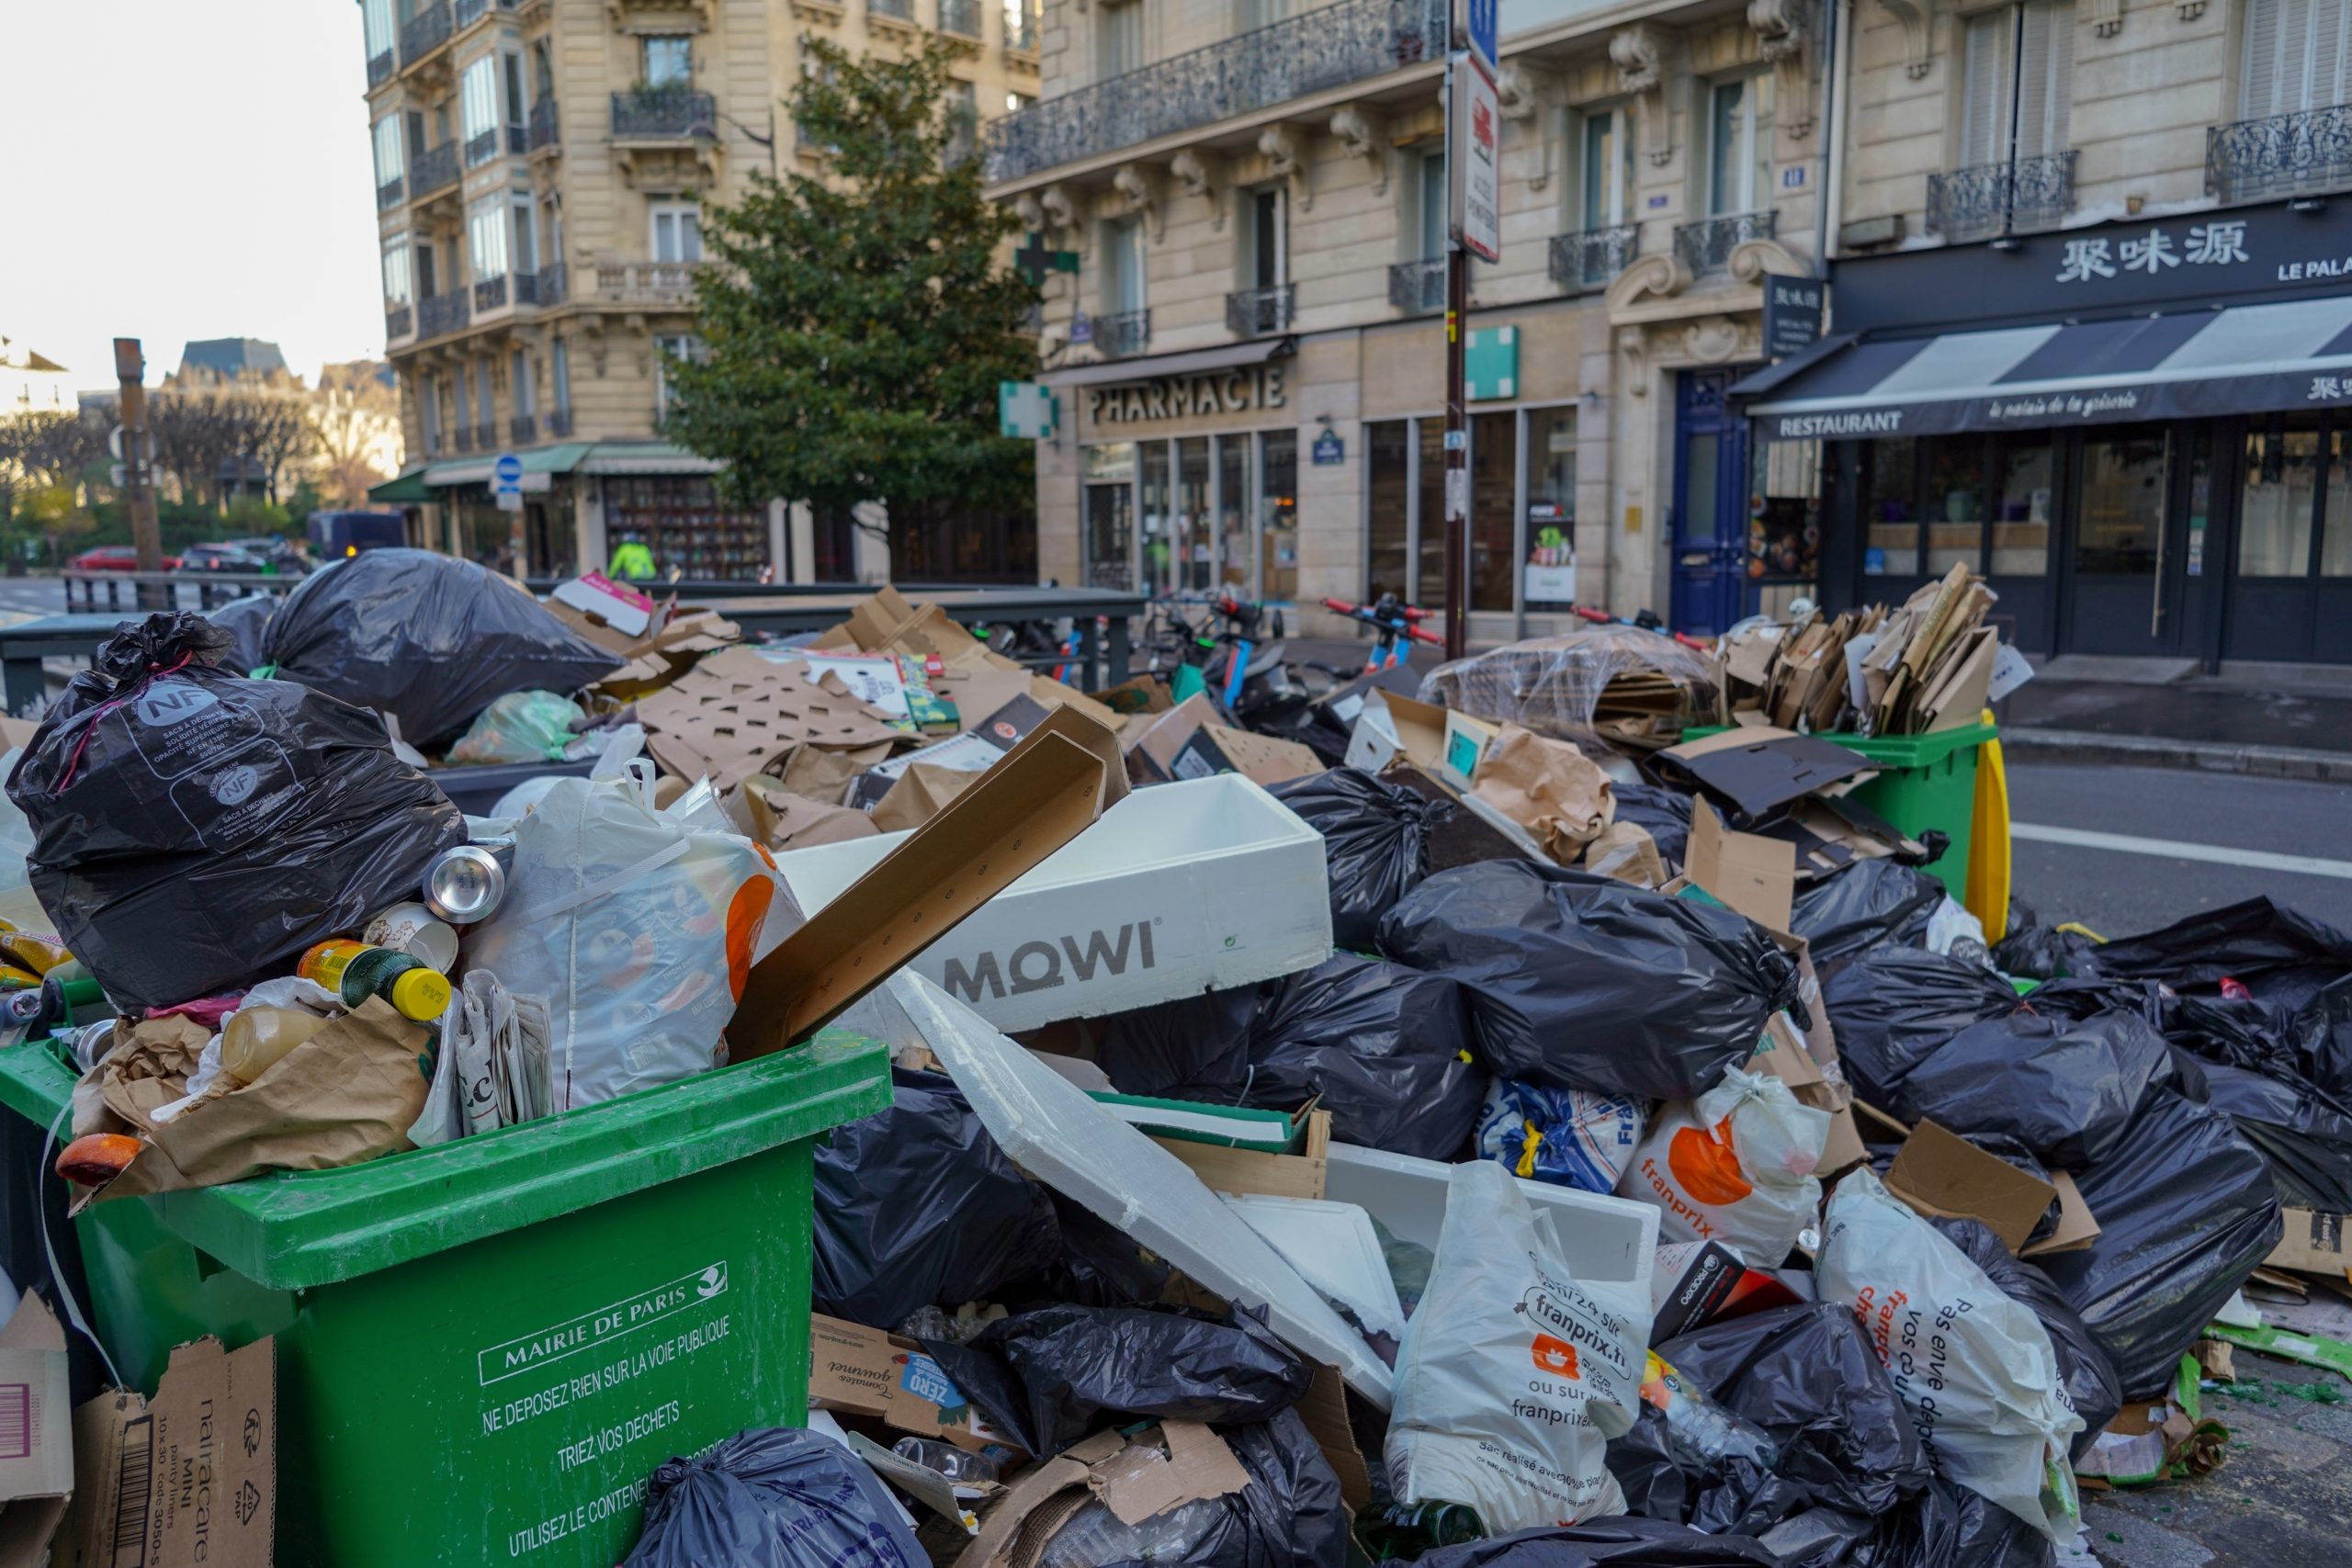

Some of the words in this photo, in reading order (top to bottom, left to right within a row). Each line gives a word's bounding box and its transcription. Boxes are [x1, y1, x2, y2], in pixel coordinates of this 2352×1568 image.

[2055, 220, 2250, 283] 聚味源
[2278, 263, 2302, 281] LE
[1089, 368, 1286, 425] PHARMACIE
[1780, 411, 1903, 436] RESTAURANT
[146, 689, 204, 718] NF
[153, 743, 185, 763] OPACITÉ
[185, 720, 231, 747] SUPÉRIEURE
[163, 726, 184, 739] SACS
[165, 727, 199, 748] SOLIDITÉ
[187, 747, 197, 756] NF
[198, 741, 209, 750] EN
[223, 773, 249, 797] NF
[222, 810, 242, 824] SACS
[944, 919, 1155, 1003] MOWI
[1640, 1157, 1714, 1239] franprix
[1680, 1268, 1709, 1305] PROEXPO
[505, 1325, 587, 1369] MAIRIE
[594, 1312, 624, 1337] DE
[629, 1286, 686, 1323] PARIS
[1901, 1310, 1922, 1348] vos
[1935, 1297, 1973, 1332] Pas
[483, 1406, 503, 1435] NE
[504, 1382, 569, 1427] DEPOSEZ
[571, 1371, 601, 1401] RIEN
[604, 1359, 630, 1388] SUR
[632, 1353, 648, 1377] LA
[648, 1338, 676, 1368] VOIE
[677, 1314, 730, 1357] PUBLIQUE
[829, 1361, 895, 1382] gourmet
[1929, 1334, 1947, 1392] envie
[838, 1374, 894, 1400] Tomates
[910, 1374, 948, 1403] ZÉRO
[1528, 1380, 1553, 1395] ou
[1558, 1385, 1587, 1400] sur
[158, 1416, 167, 1433] 10
[557, 1435, 595, 1472] TRIEZ
[596, 1425, 624, 1455] VOS
[626, 1400, 680, 1444] DECHETS
[158, 1448, 167, 1464] 30
[169, 1444, 178, 1489] panty
[1478, 1441, 1499, 1456] Sac
[1502, 1450, 1537, 1471] réalisé
[156, 1472, 166, 1509] code
[180, 1458, 194, 1509] MINI
[166, 1490, 177, 1530] liners
[508, 1511, 573, 1558] UTILISEZ
[570, 1506, 586, 1533] LE
